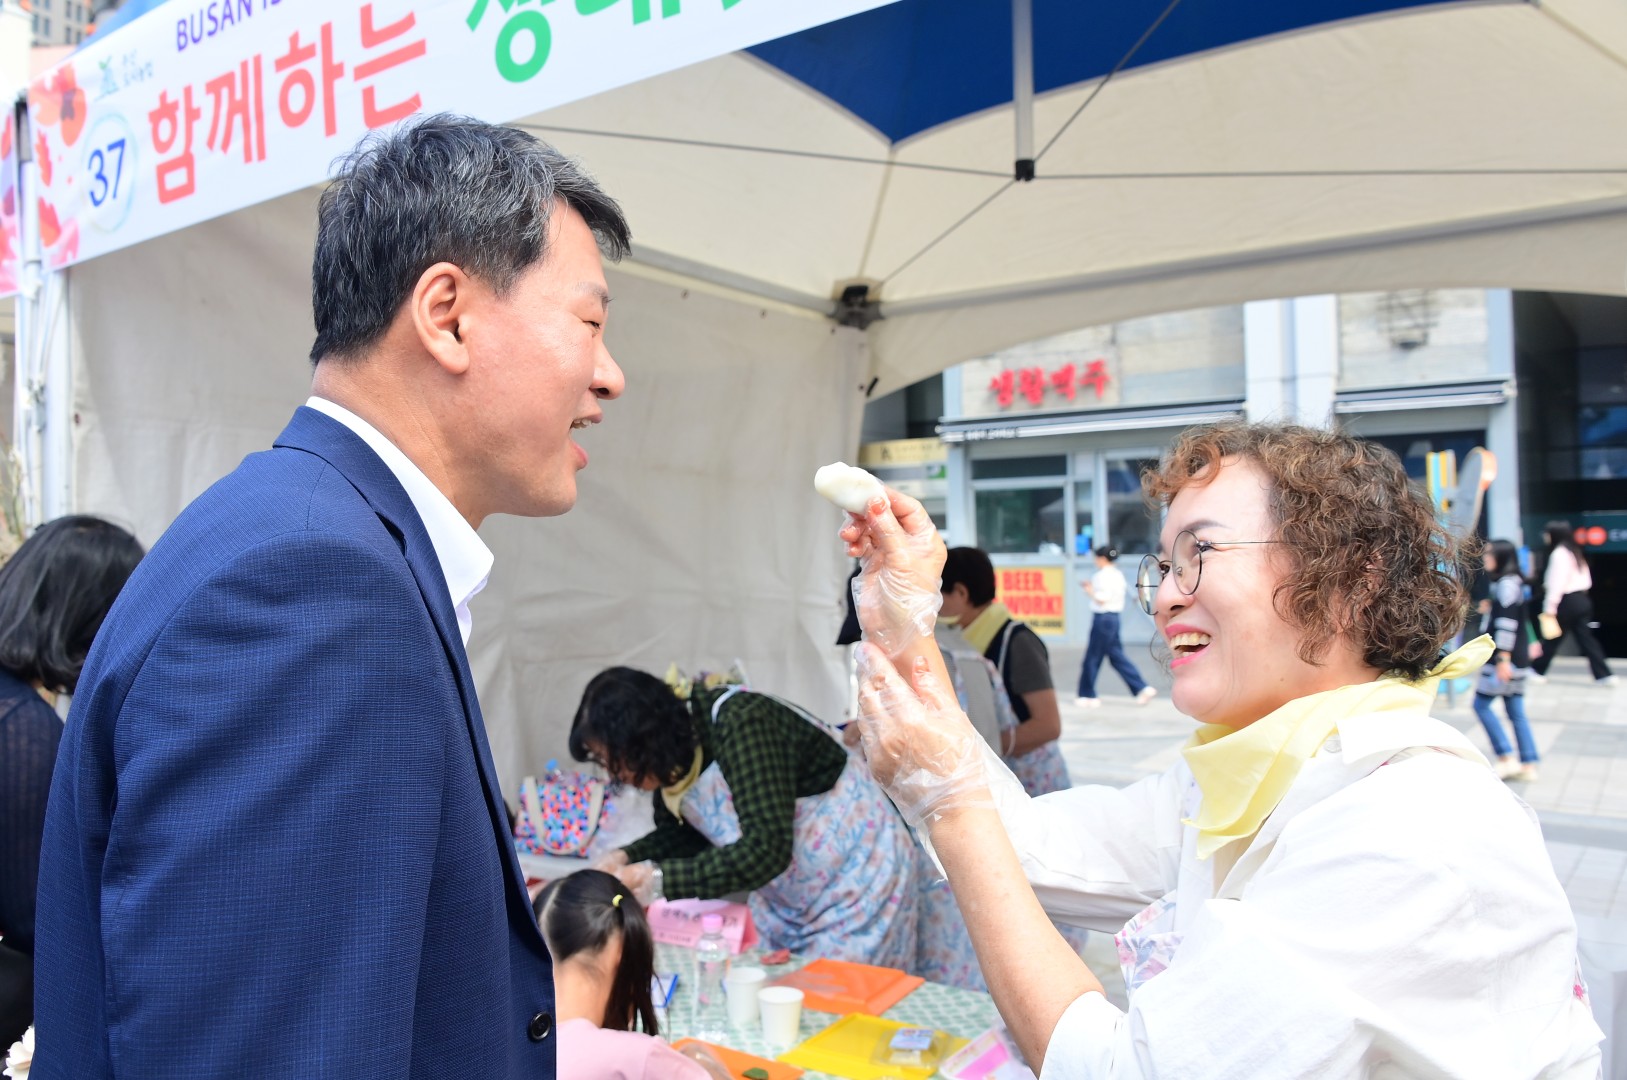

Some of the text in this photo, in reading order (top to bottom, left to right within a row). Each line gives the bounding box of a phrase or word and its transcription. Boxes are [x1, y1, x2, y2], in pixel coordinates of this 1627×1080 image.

[177, 0, 253, 52] BUSAN
[148, 2, 427, 205] 함께하는
[87, 138, 126, 207] 37
